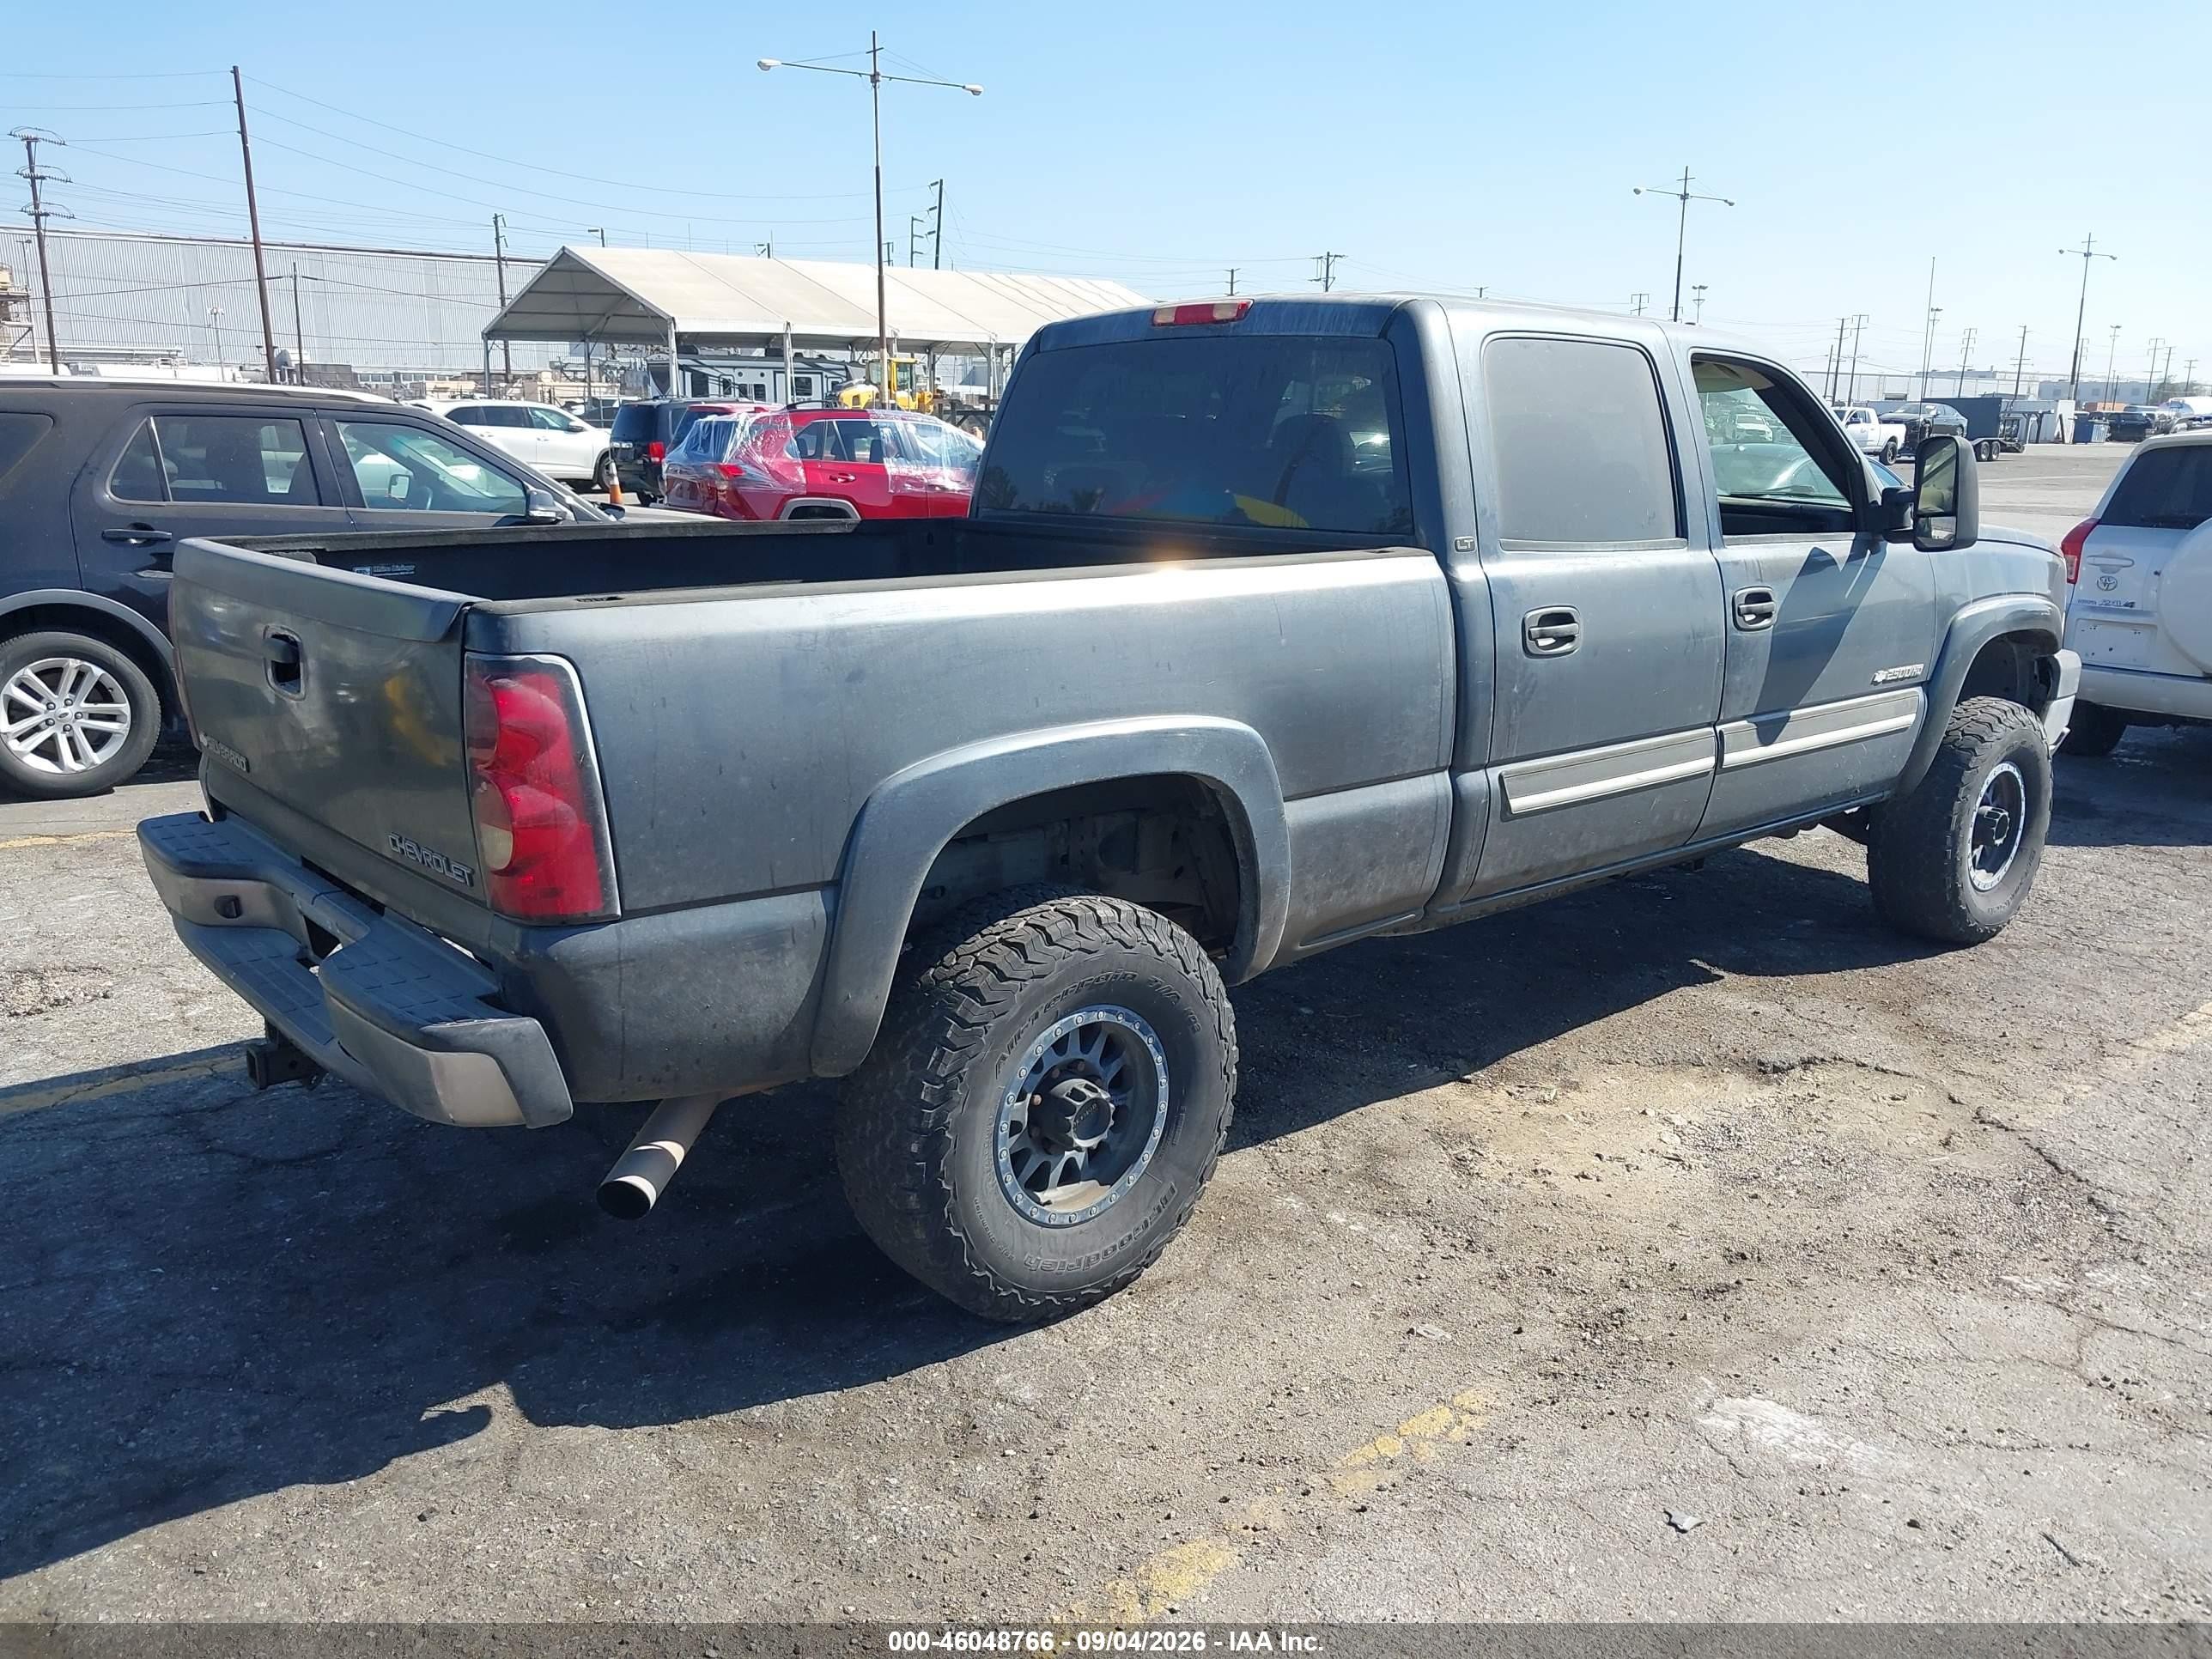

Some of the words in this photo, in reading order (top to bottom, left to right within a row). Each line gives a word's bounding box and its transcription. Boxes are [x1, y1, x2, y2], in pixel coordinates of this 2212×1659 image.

[1456, 538, 1474, 550] LT
[1885, 664, 1924, 680] 2500HD
[388, 832, 474, 887] CHEVROLET
[1024, 1181, 1178, 1275] BFGoodrich
